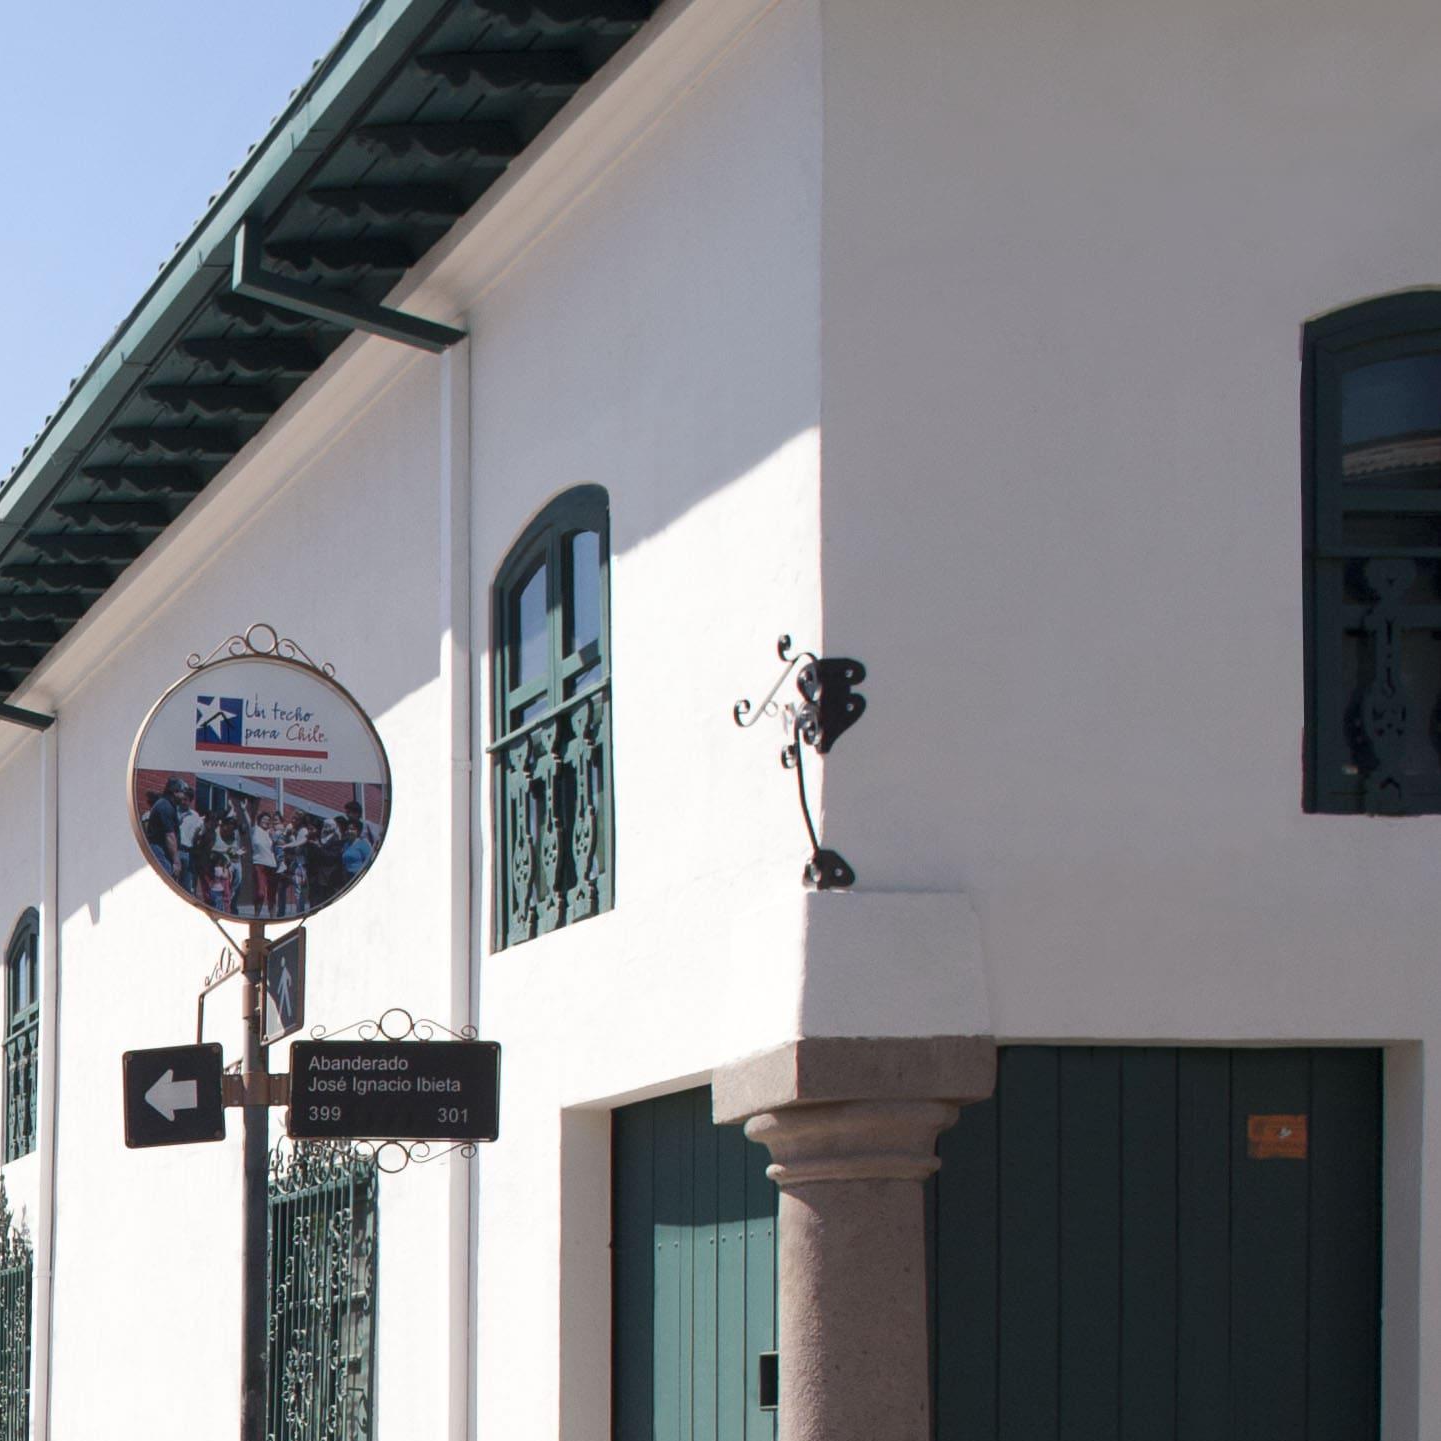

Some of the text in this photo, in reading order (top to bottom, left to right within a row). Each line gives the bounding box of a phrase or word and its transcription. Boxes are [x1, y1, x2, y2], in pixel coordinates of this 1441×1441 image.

[245, 694, 314, 722] Un techo
[244, 726, 280, 746] para
[202, 757, 322, 775] www.untechoparachile.cl
[308, 1056, 408, 1071] Abanderado
[308, 1077, 461, 1096] José Ignacio Ibieta
[309, 1106, 468, 1124] 399 301
